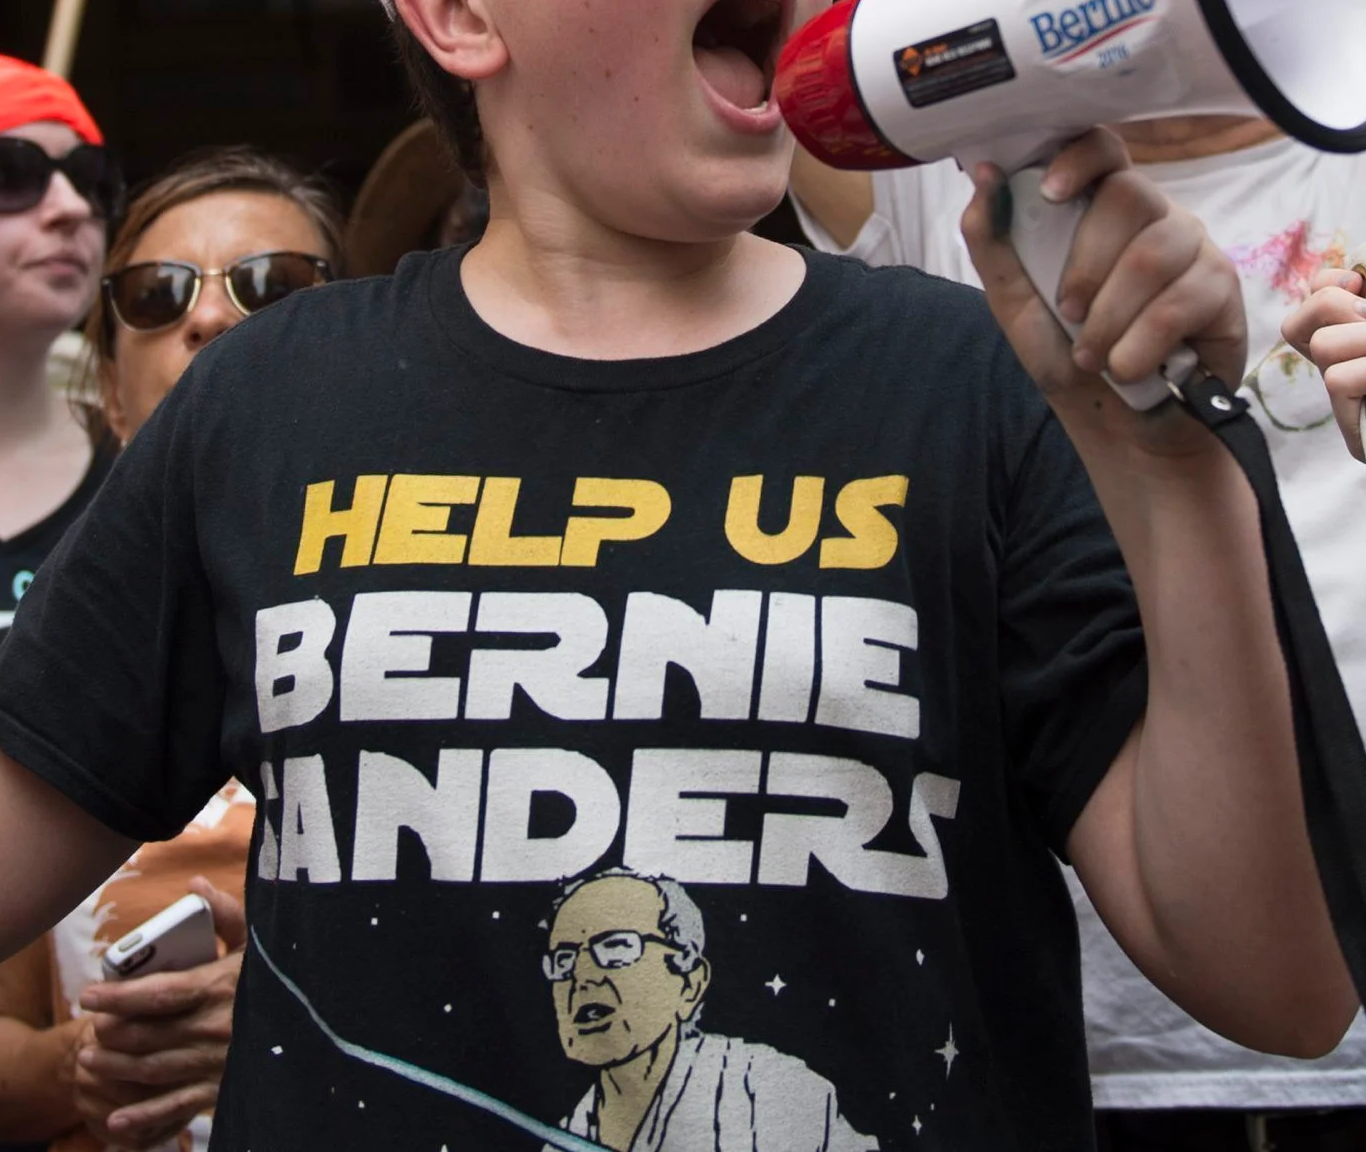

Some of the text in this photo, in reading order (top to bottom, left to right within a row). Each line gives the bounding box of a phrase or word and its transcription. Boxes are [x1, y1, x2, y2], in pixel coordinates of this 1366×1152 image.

[292, 474, 910, 576] HELP US
[255, 588, 921, 735] BERNIE
